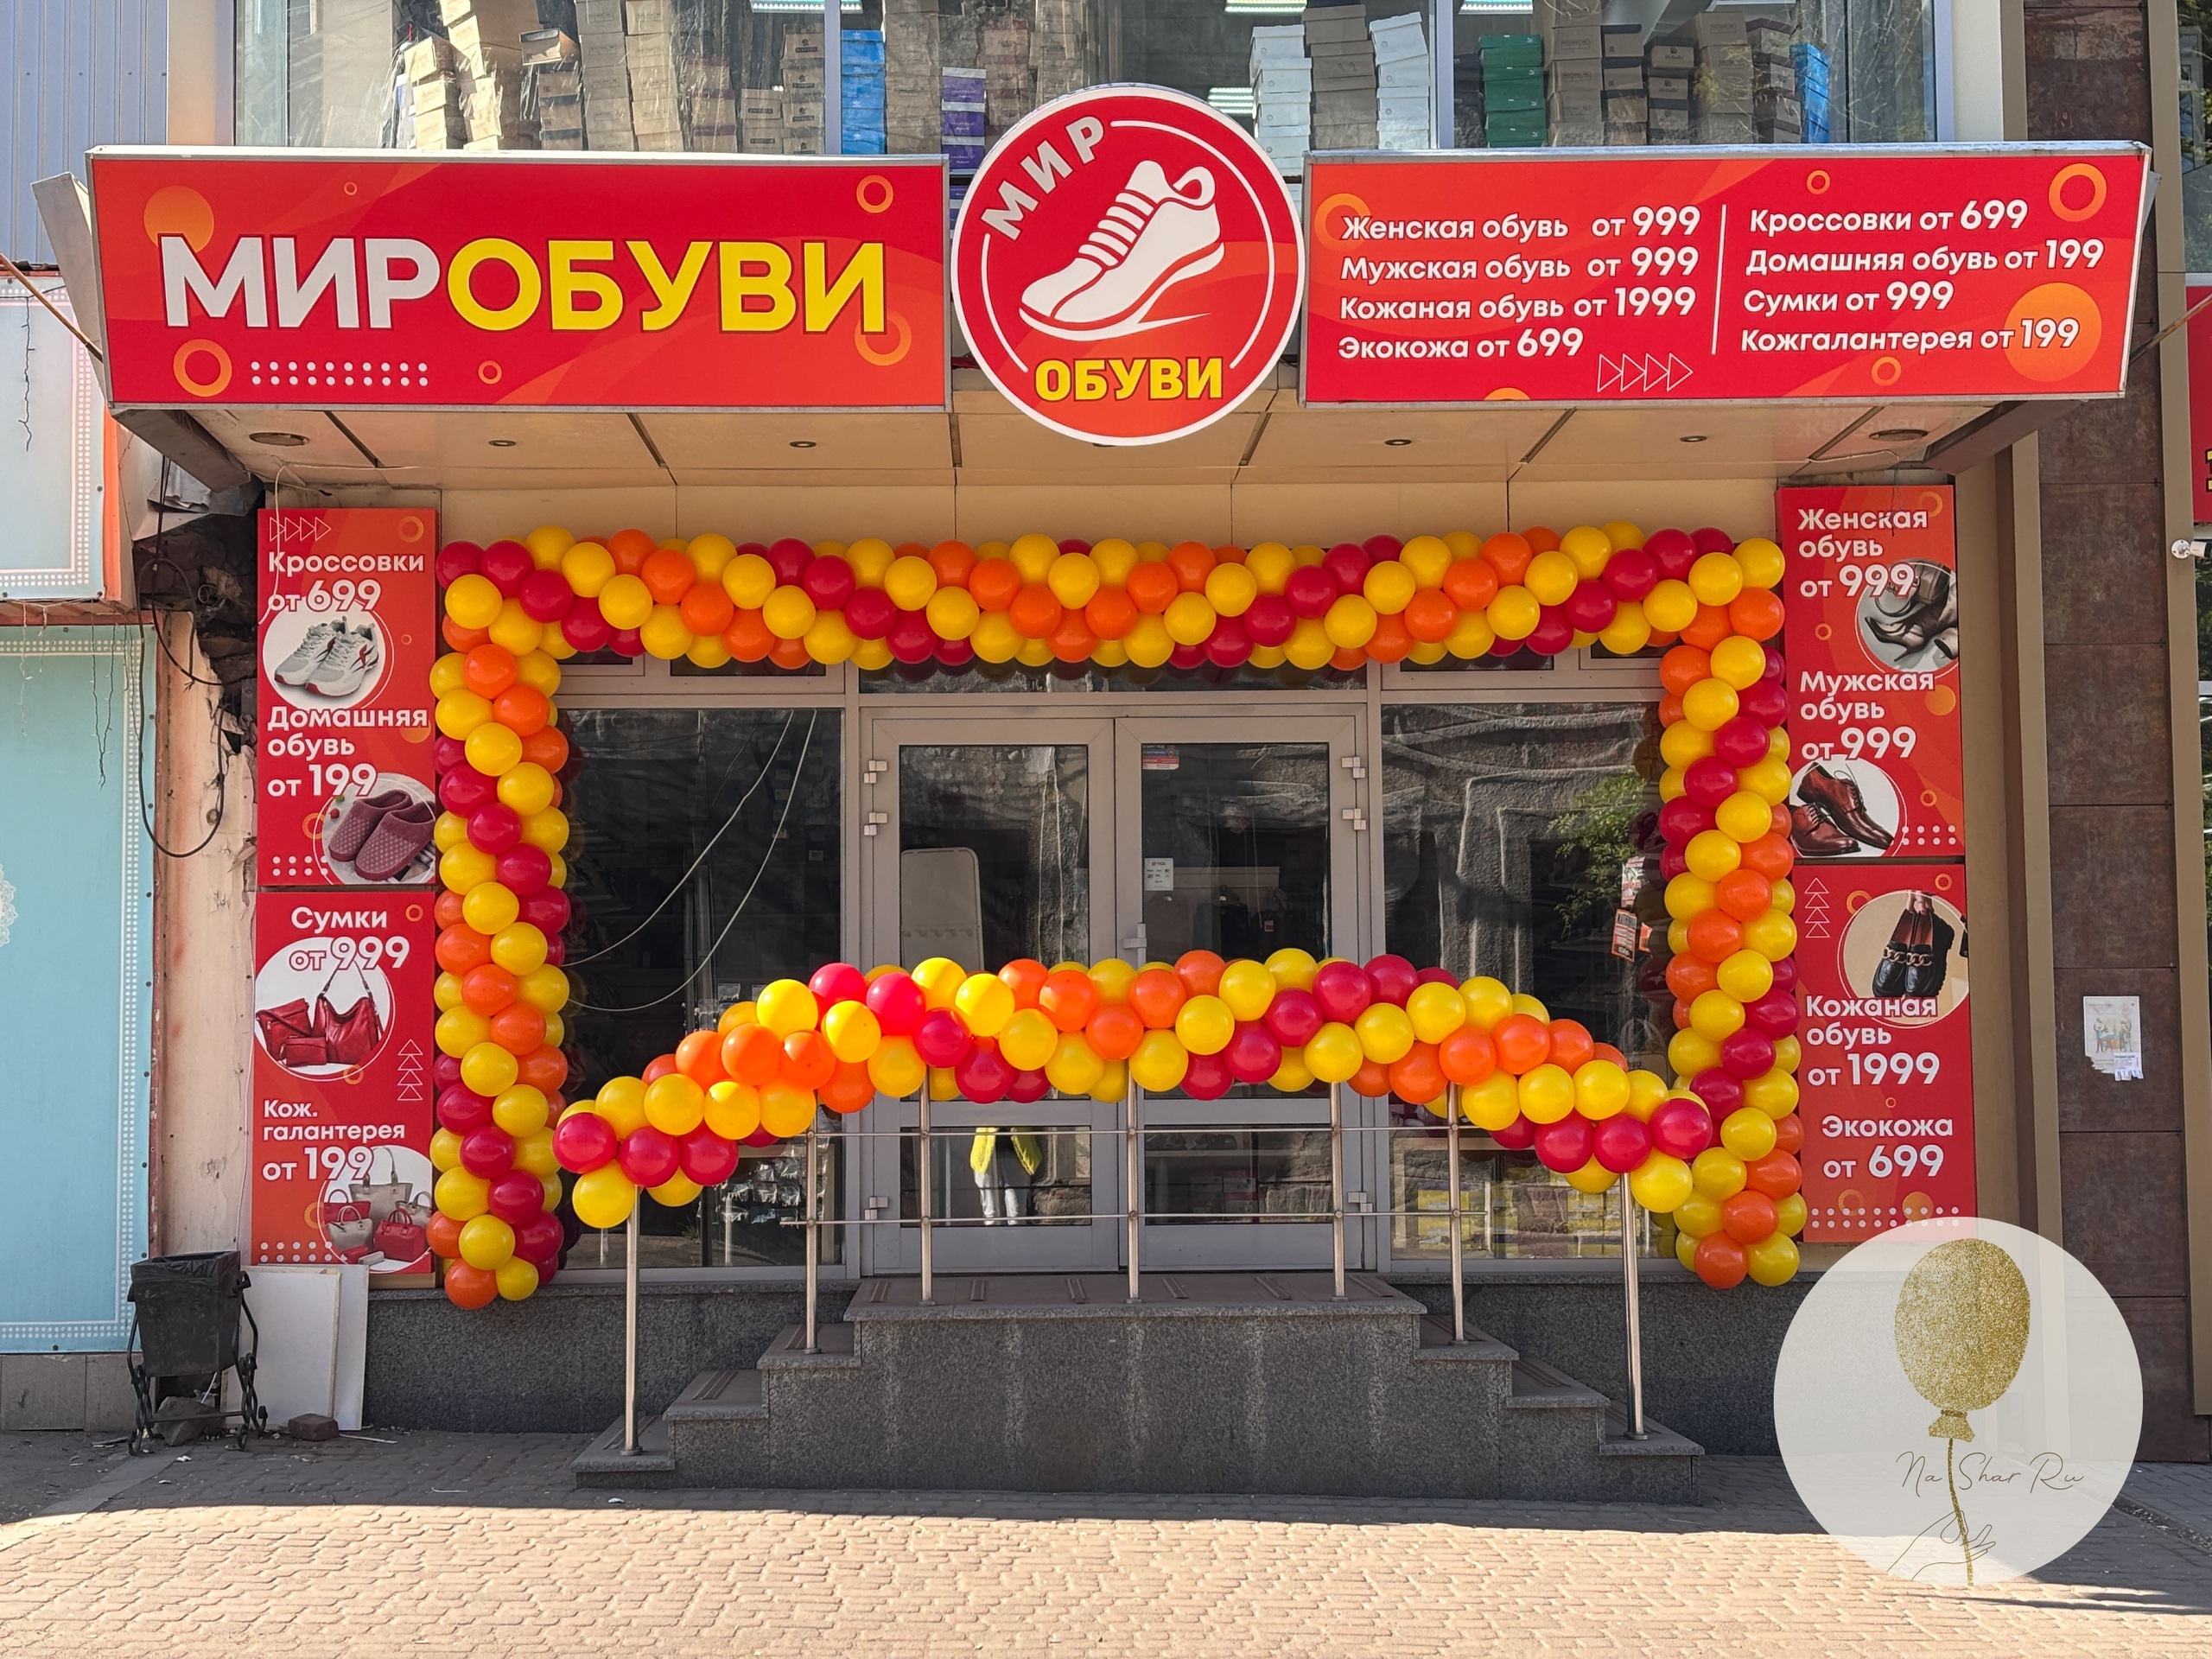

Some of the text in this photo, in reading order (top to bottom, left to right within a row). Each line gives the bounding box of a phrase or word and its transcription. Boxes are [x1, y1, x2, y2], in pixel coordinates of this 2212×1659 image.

[976, 111, 1106, 245] МИР
[1342, 206, 1700, 244] Женская обувь от 999
[1750, 199, 2028, 238] Кроссовки от 699
[1341, 246, 1699, 285] Мужская обувь от 999
[1745, 238, 2104, 276] Домашняя обувь от 199
[1341, 286, 1696, 323] Кожаная обувь от 1999
[1744, 280, 1954, 317] Сумки от 999
[1338, 327, 1584, 359] Экокожа от 699
[1741, 318, 2079, 354] Кожгалантерея от 199
[1035, 357, 1223, 401] ОБУВИ
[1797, 508, 1929, 531] Женская
[268, 552, 425, 578] Кроссовки
[1799, 534, 1883, 563] обувь
[269, 581, 381, 612] от 699
[1800, 564, 1916, 597] от 999
[1799, 670, 1935, 696] Мужская
[268, 706, 429, 731] Домашняя
[1801, 696, 1885, 725] обувь
[267, 734, 355, 760] обувь
[1802, 726, 1917, 761] от 999
[267, 763, 378, 798] от 199
[291, 906, 387, 934] Сумки
[289, 935, 412, 973] от 999
[1806, 995, 1937, 1020] Кожаная
[1807, 1021, 1892, 1051] обувь
[1808, 1052, 1940, 1086] от 1999
[264, 1099, 318, 1118] Кож.
[264, 1124, 405, 1144] галантерея
[1822, 1116, 1953, 1137] Экокожа
[263, 1146, 374, 1182] от 199
[1823, 1144, 1944, 1179] от 699
